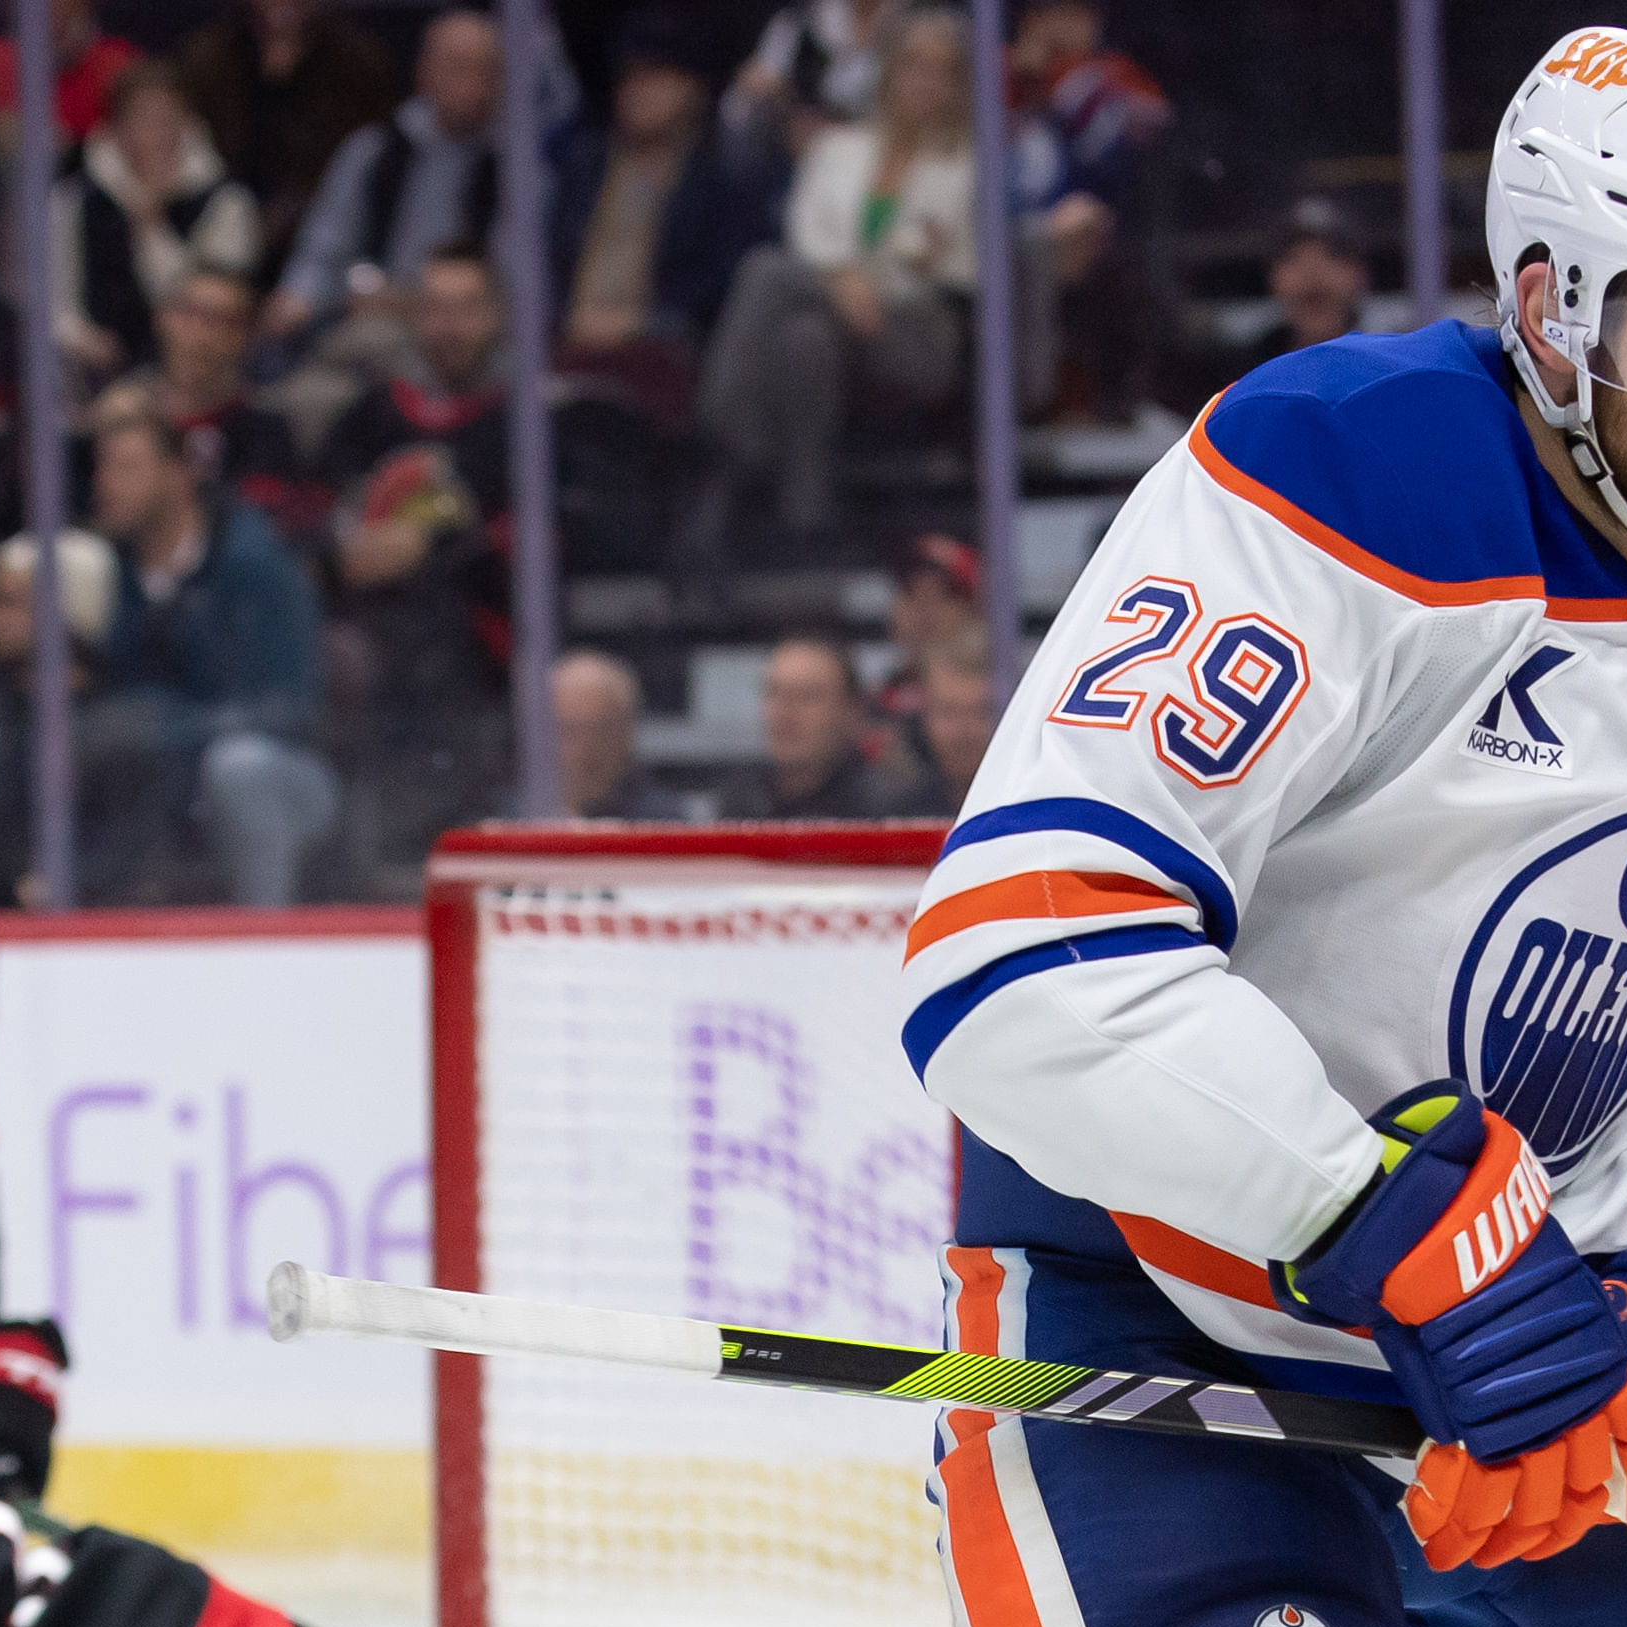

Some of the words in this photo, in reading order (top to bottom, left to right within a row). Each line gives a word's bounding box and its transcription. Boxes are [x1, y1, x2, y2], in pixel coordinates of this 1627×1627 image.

[1046, 575, 1311, 790] 29
[1467, 729, 1563, 769] KARBON-X
[744, 1348, 783, 1361] PRO
